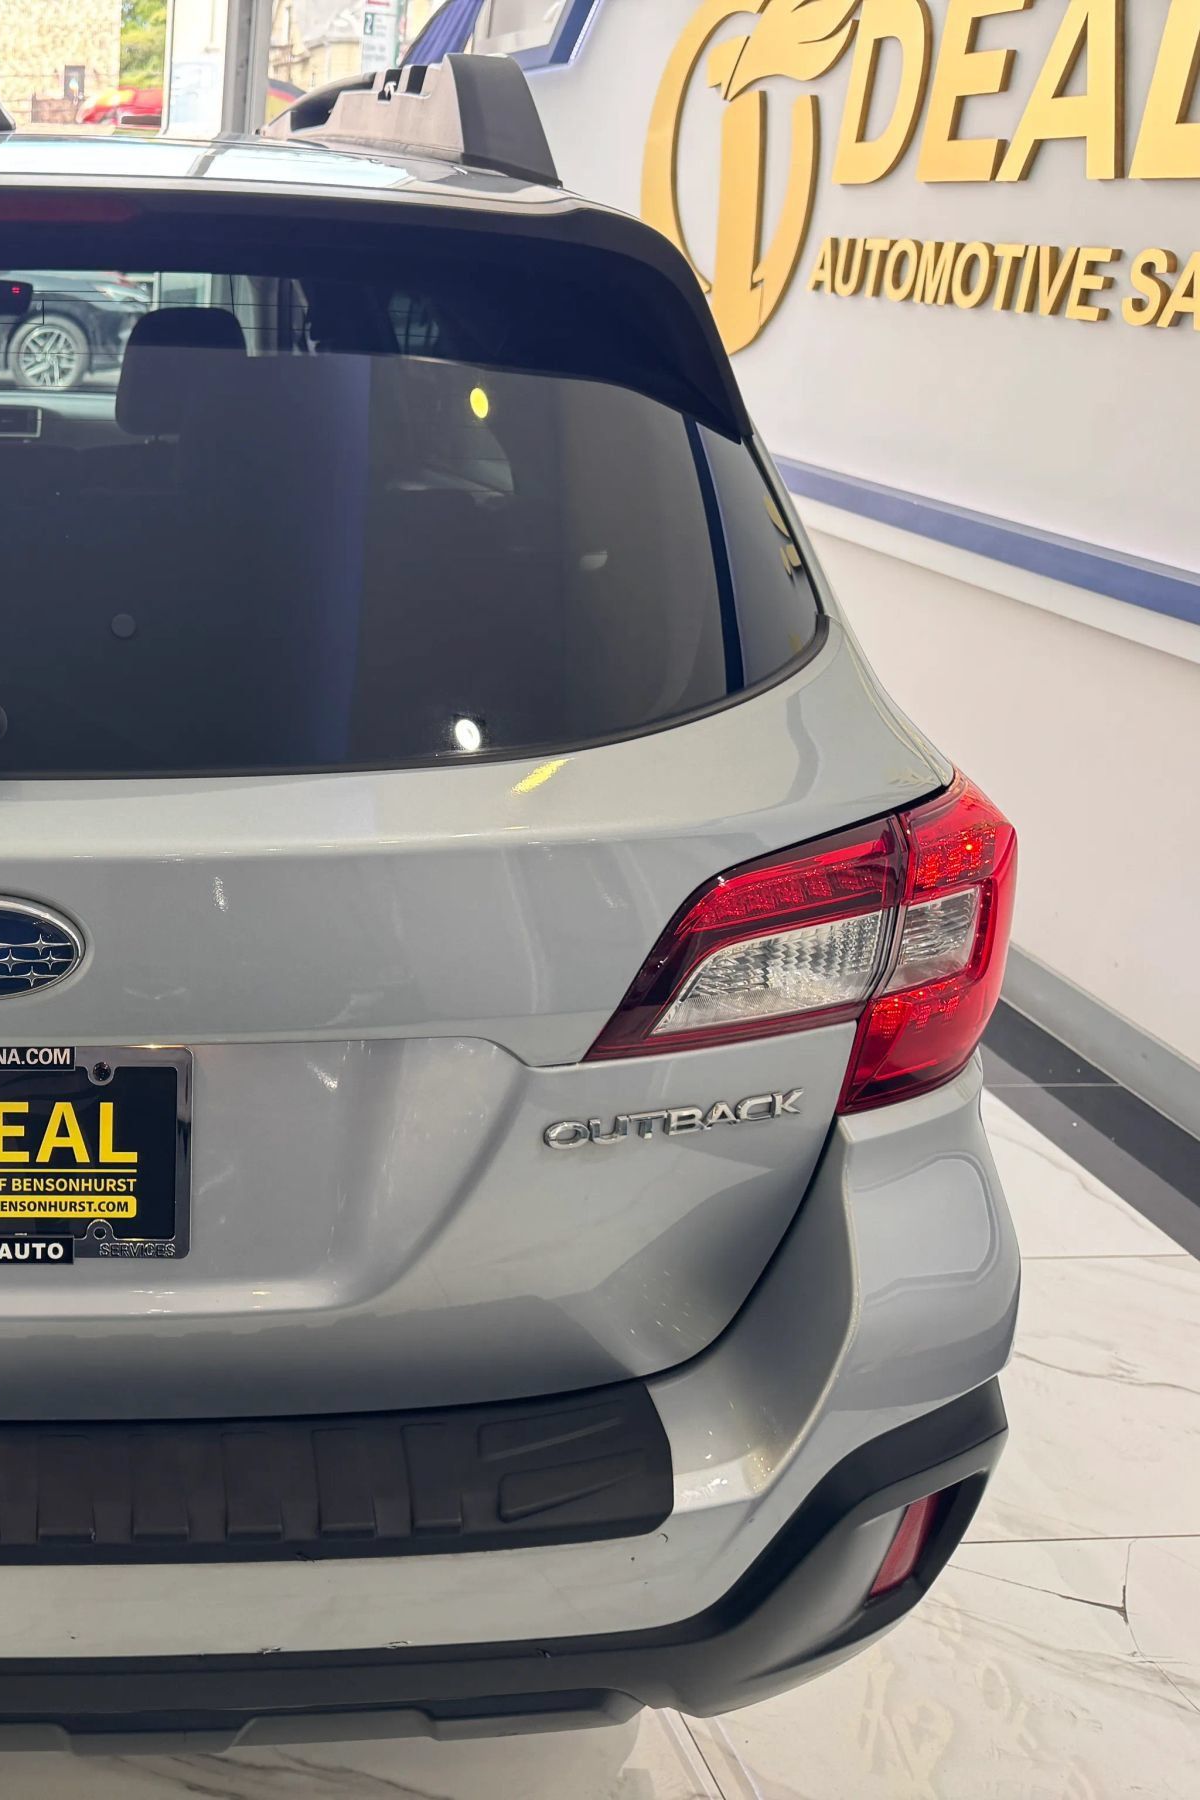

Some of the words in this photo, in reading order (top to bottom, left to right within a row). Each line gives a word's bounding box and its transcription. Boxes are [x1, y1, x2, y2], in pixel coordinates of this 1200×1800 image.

[808, 237, 1118, 323] AUTOMOTIVE
[543, 1087, 804, 1150] OUTBACK
[11, 1178, 137, 1192] BENSONHURST
[98, 1243, 176, 1258] SERVICES
